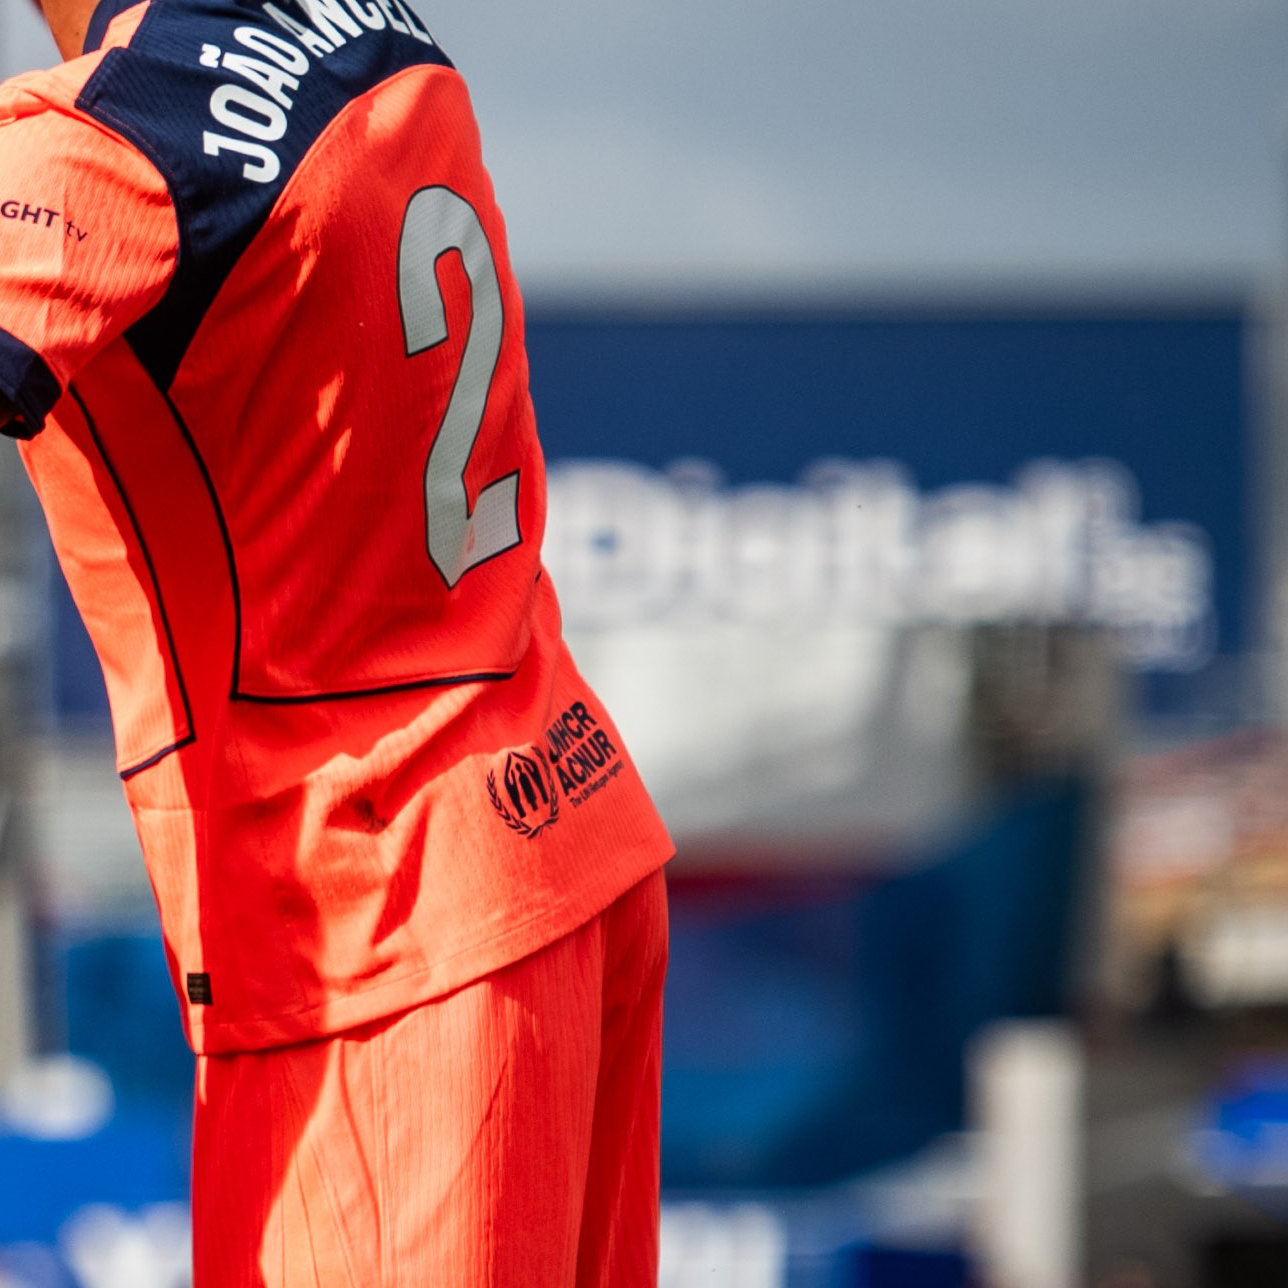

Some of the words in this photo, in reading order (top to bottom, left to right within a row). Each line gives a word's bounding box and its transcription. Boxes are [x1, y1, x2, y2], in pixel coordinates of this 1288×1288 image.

[199, 25, 310, 184] JOÃO
[66, 220, 88, 242] tv
[397, 184, 522, 591] 2
[555, 729, 618, 797] ACNUR
